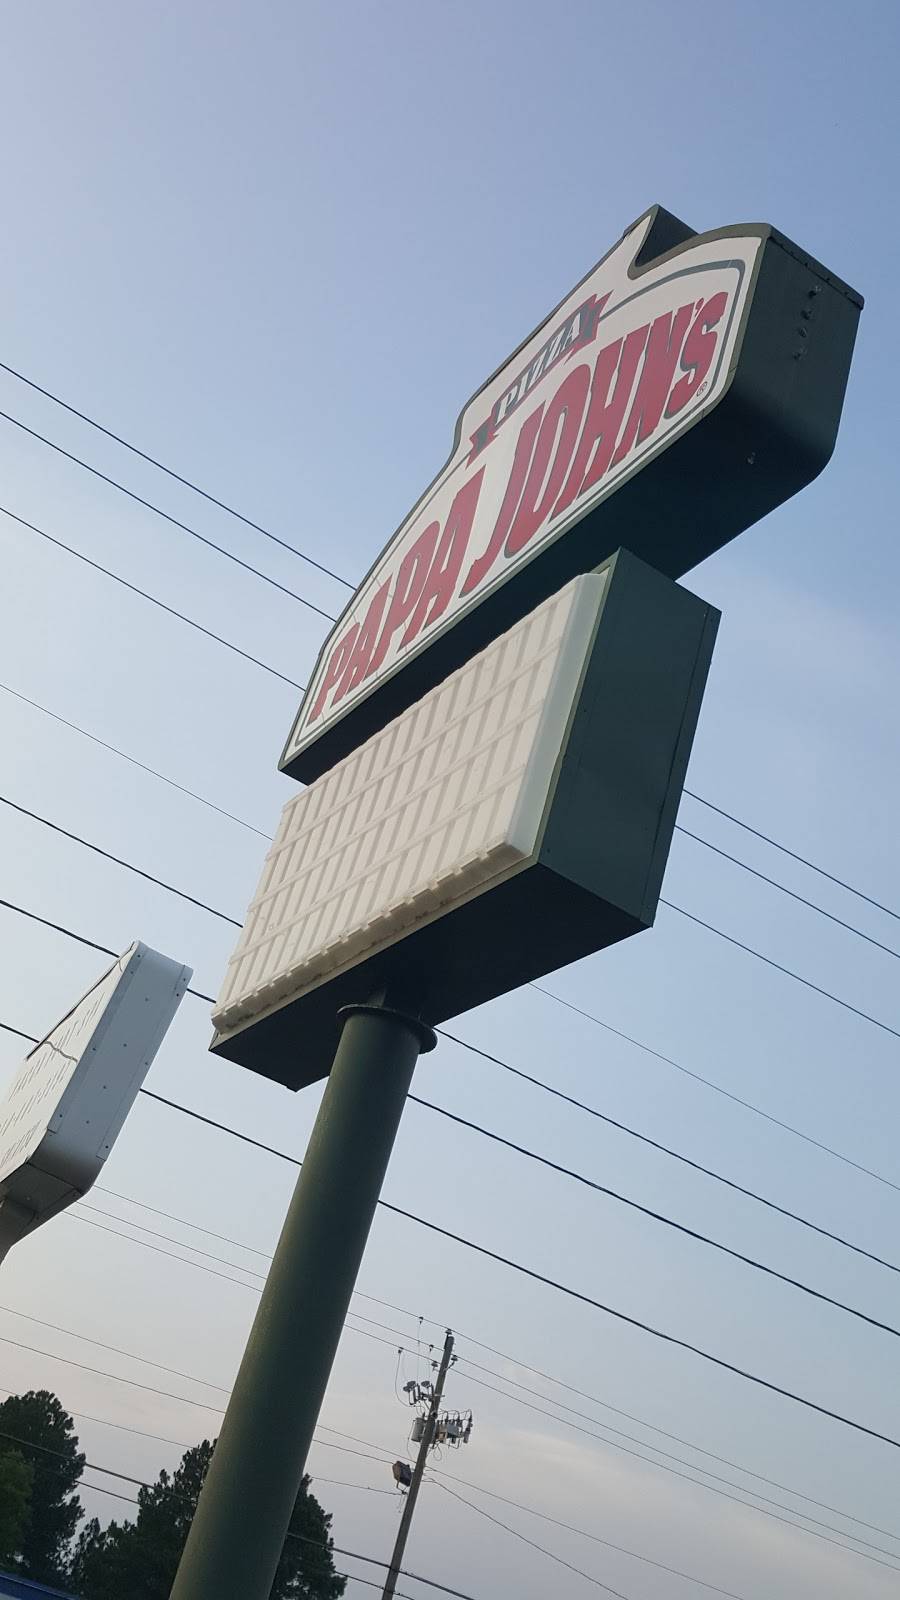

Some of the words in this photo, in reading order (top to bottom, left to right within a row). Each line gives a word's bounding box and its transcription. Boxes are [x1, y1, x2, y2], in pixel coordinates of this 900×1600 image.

[495, 312, 580, 426] PIZZA
[308, 466, 486, 722] PAPA
[460, 292, 728, 597] JOHN'S
